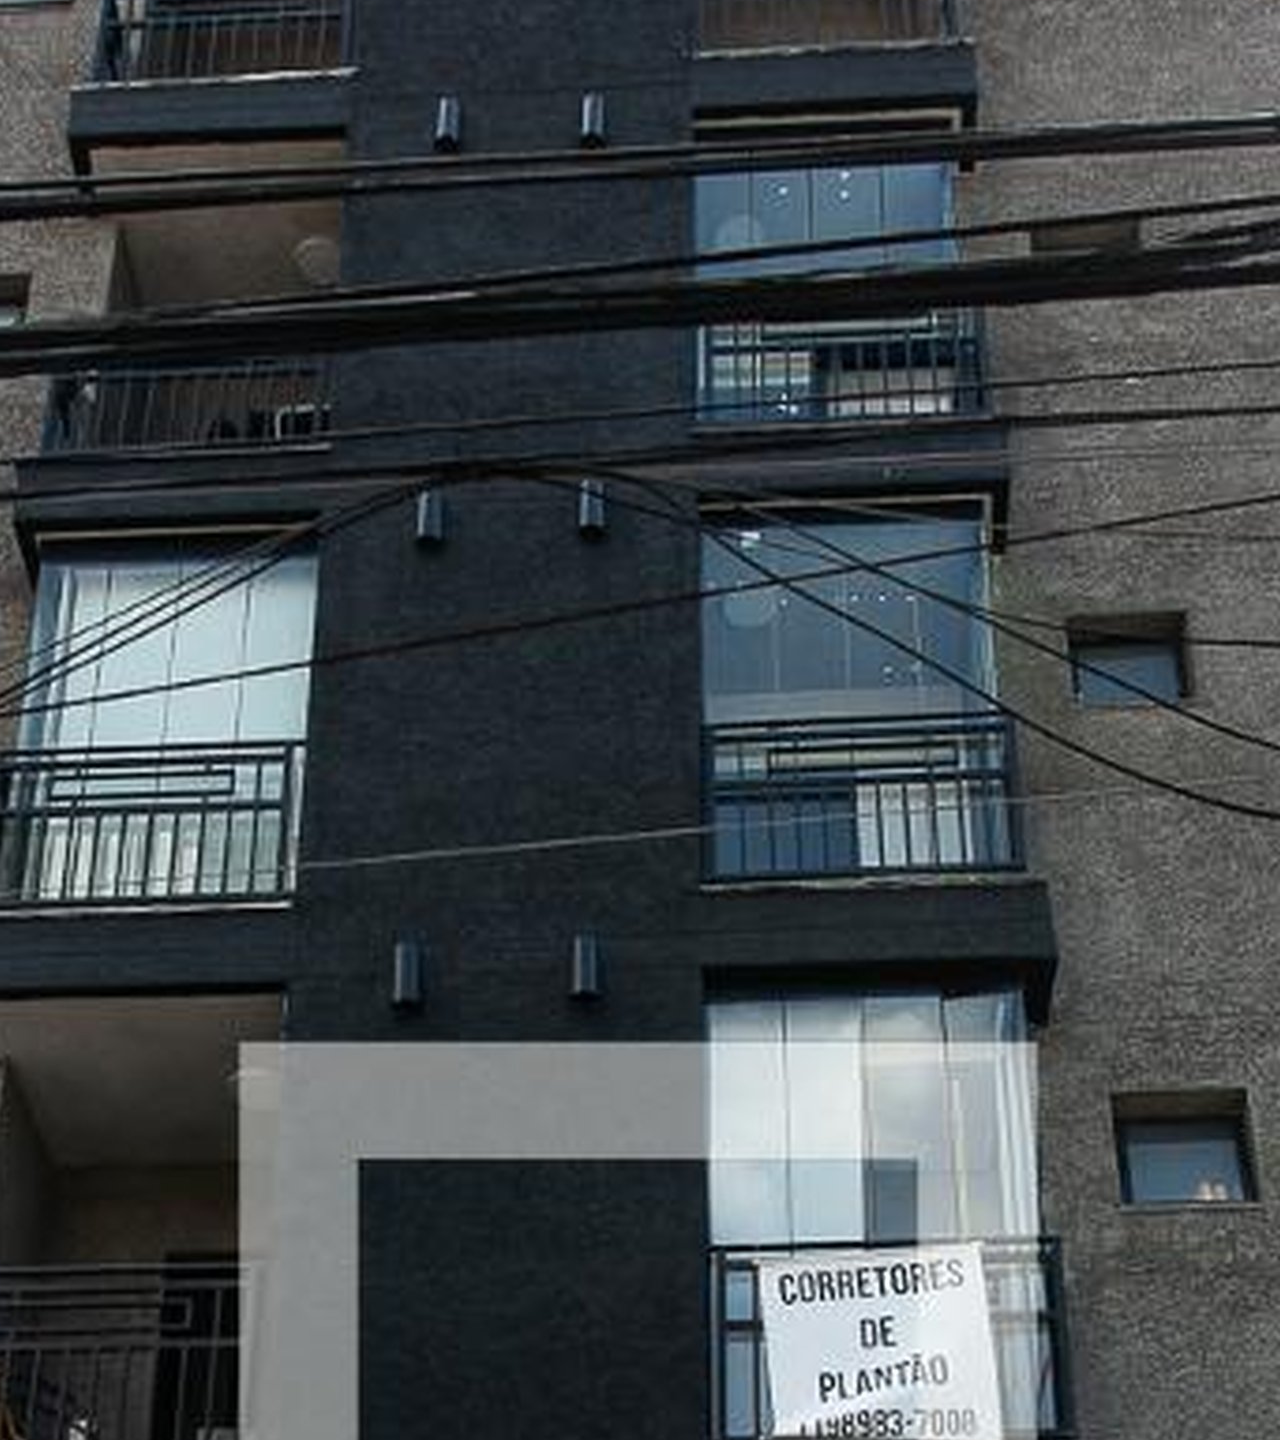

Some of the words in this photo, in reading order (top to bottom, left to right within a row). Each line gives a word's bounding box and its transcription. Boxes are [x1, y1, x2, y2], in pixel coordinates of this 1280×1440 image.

[778, 1259, 965, 1306] CORRETORES
[859, 1316, 898, 1348] DE
[819, 1354, 949, 1403] PLANTÃO
